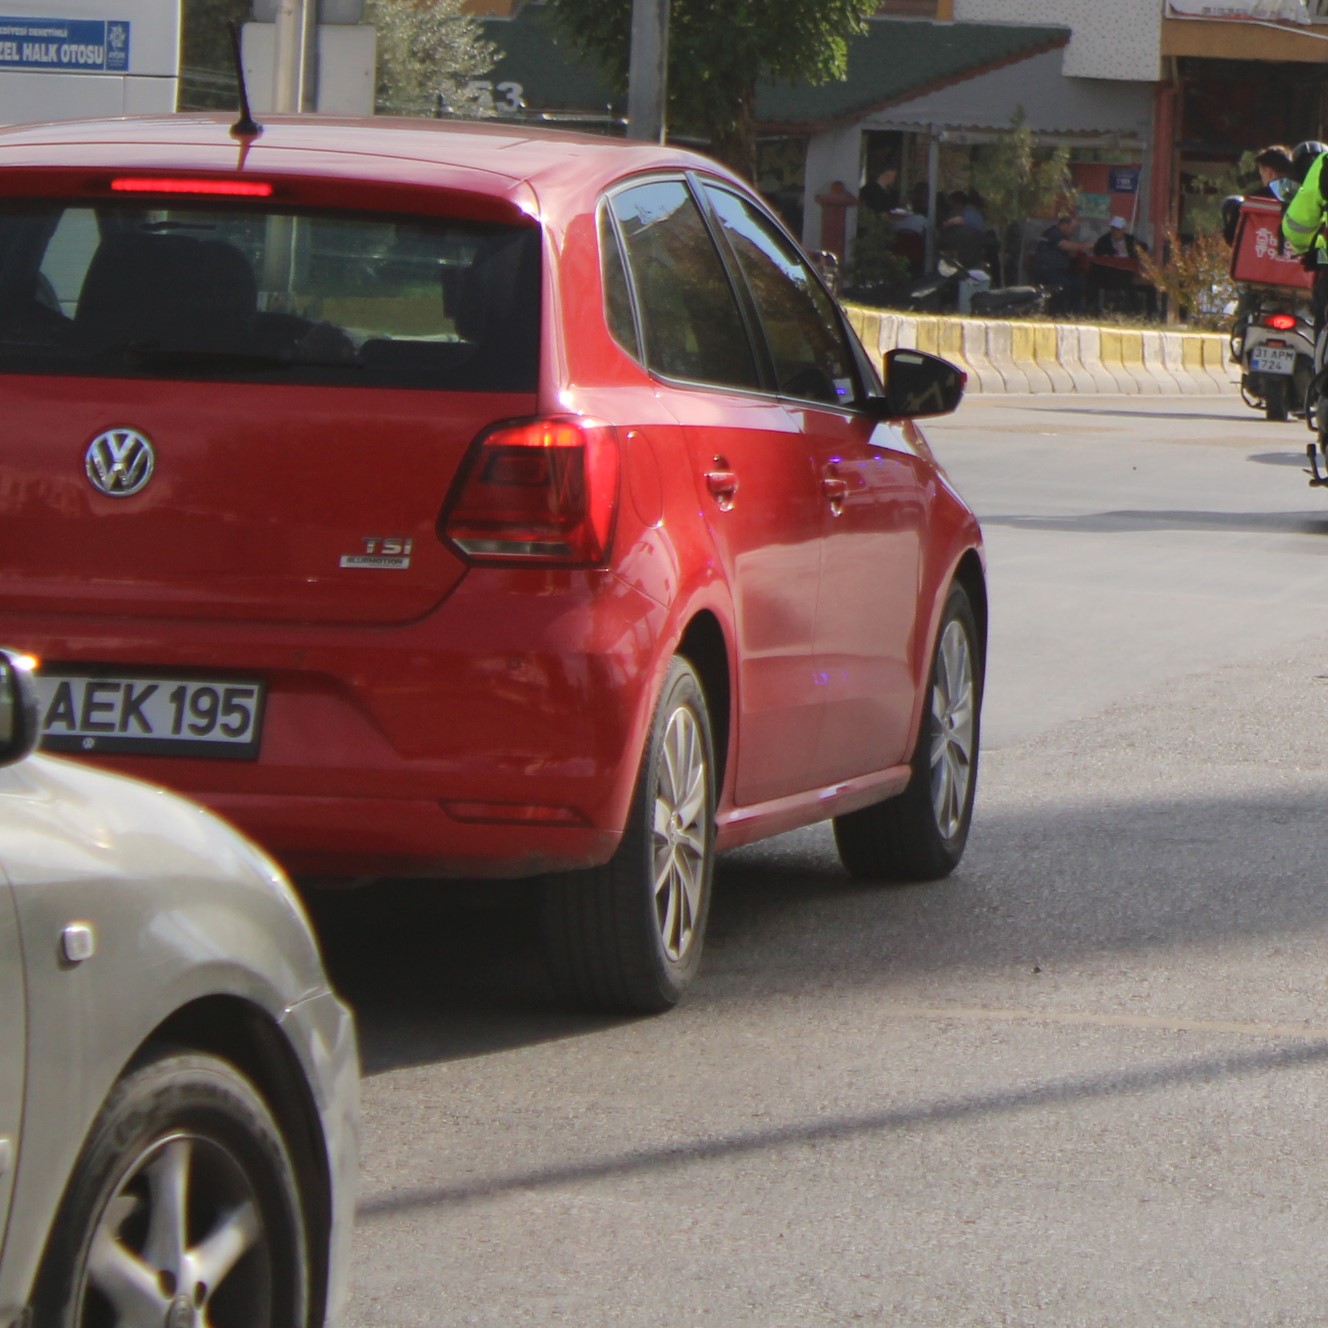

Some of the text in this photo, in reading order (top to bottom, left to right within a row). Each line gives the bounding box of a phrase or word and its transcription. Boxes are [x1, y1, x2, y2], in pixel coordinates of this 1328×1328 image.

[22, 43, 58, 63] HALK
[60, 45, 104, 64] OTOSU
[361, 537, 412, 555] TSI
[43, 681, 256, 739] AEK 195
